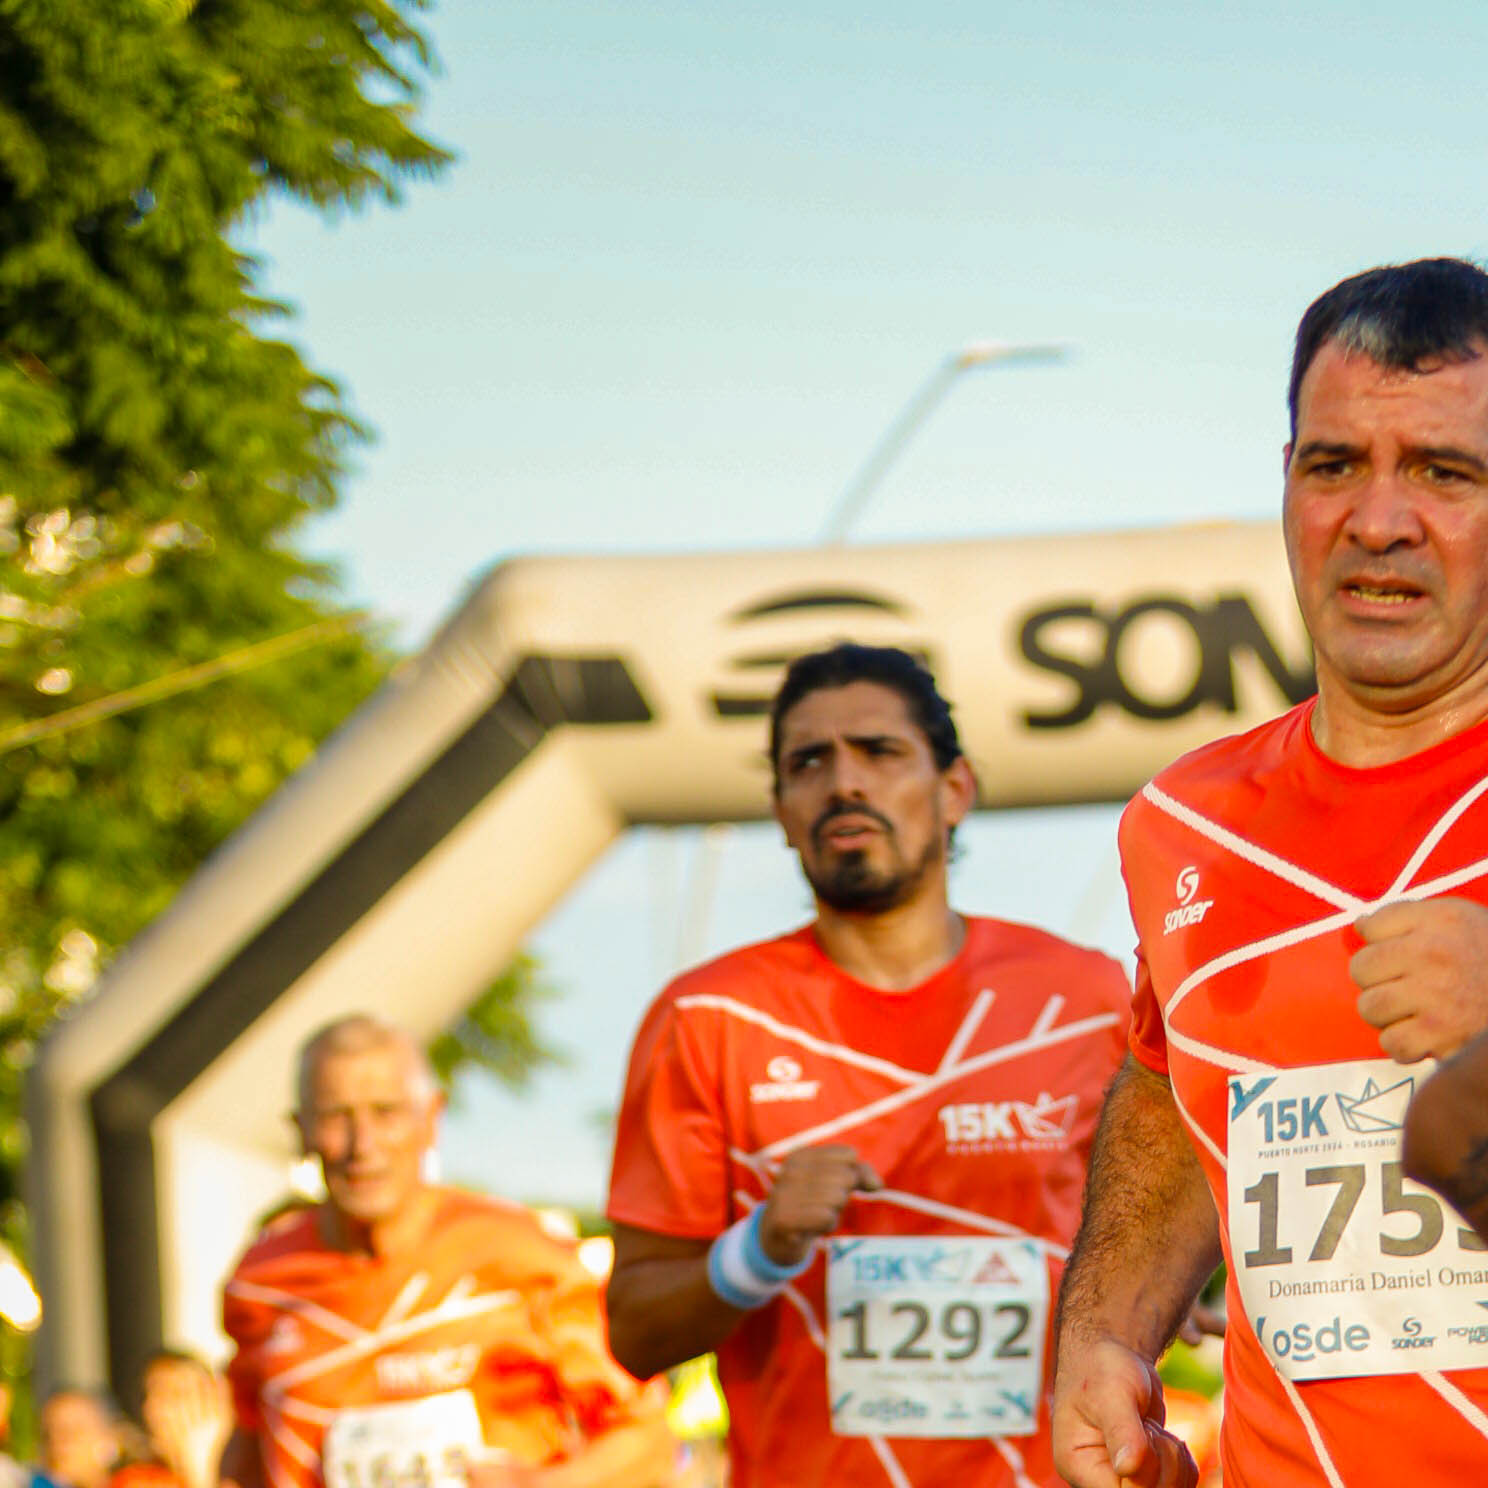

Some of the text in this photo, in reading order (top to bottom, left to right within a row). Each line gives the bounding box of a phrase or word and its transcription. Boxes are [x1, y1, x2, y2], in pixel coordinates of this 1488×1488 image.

[938, 1101, 1016, 1142] 15K
[1257, 1093, 1329, 1143] 15K
[1268, 1273, 1365, 1298] Donamaria
[1371, 1268, 1431, 1291] Daniel
[839, 1300, 1033, 1361] 1292
[1273, 1316, 1370, 1357] osde
